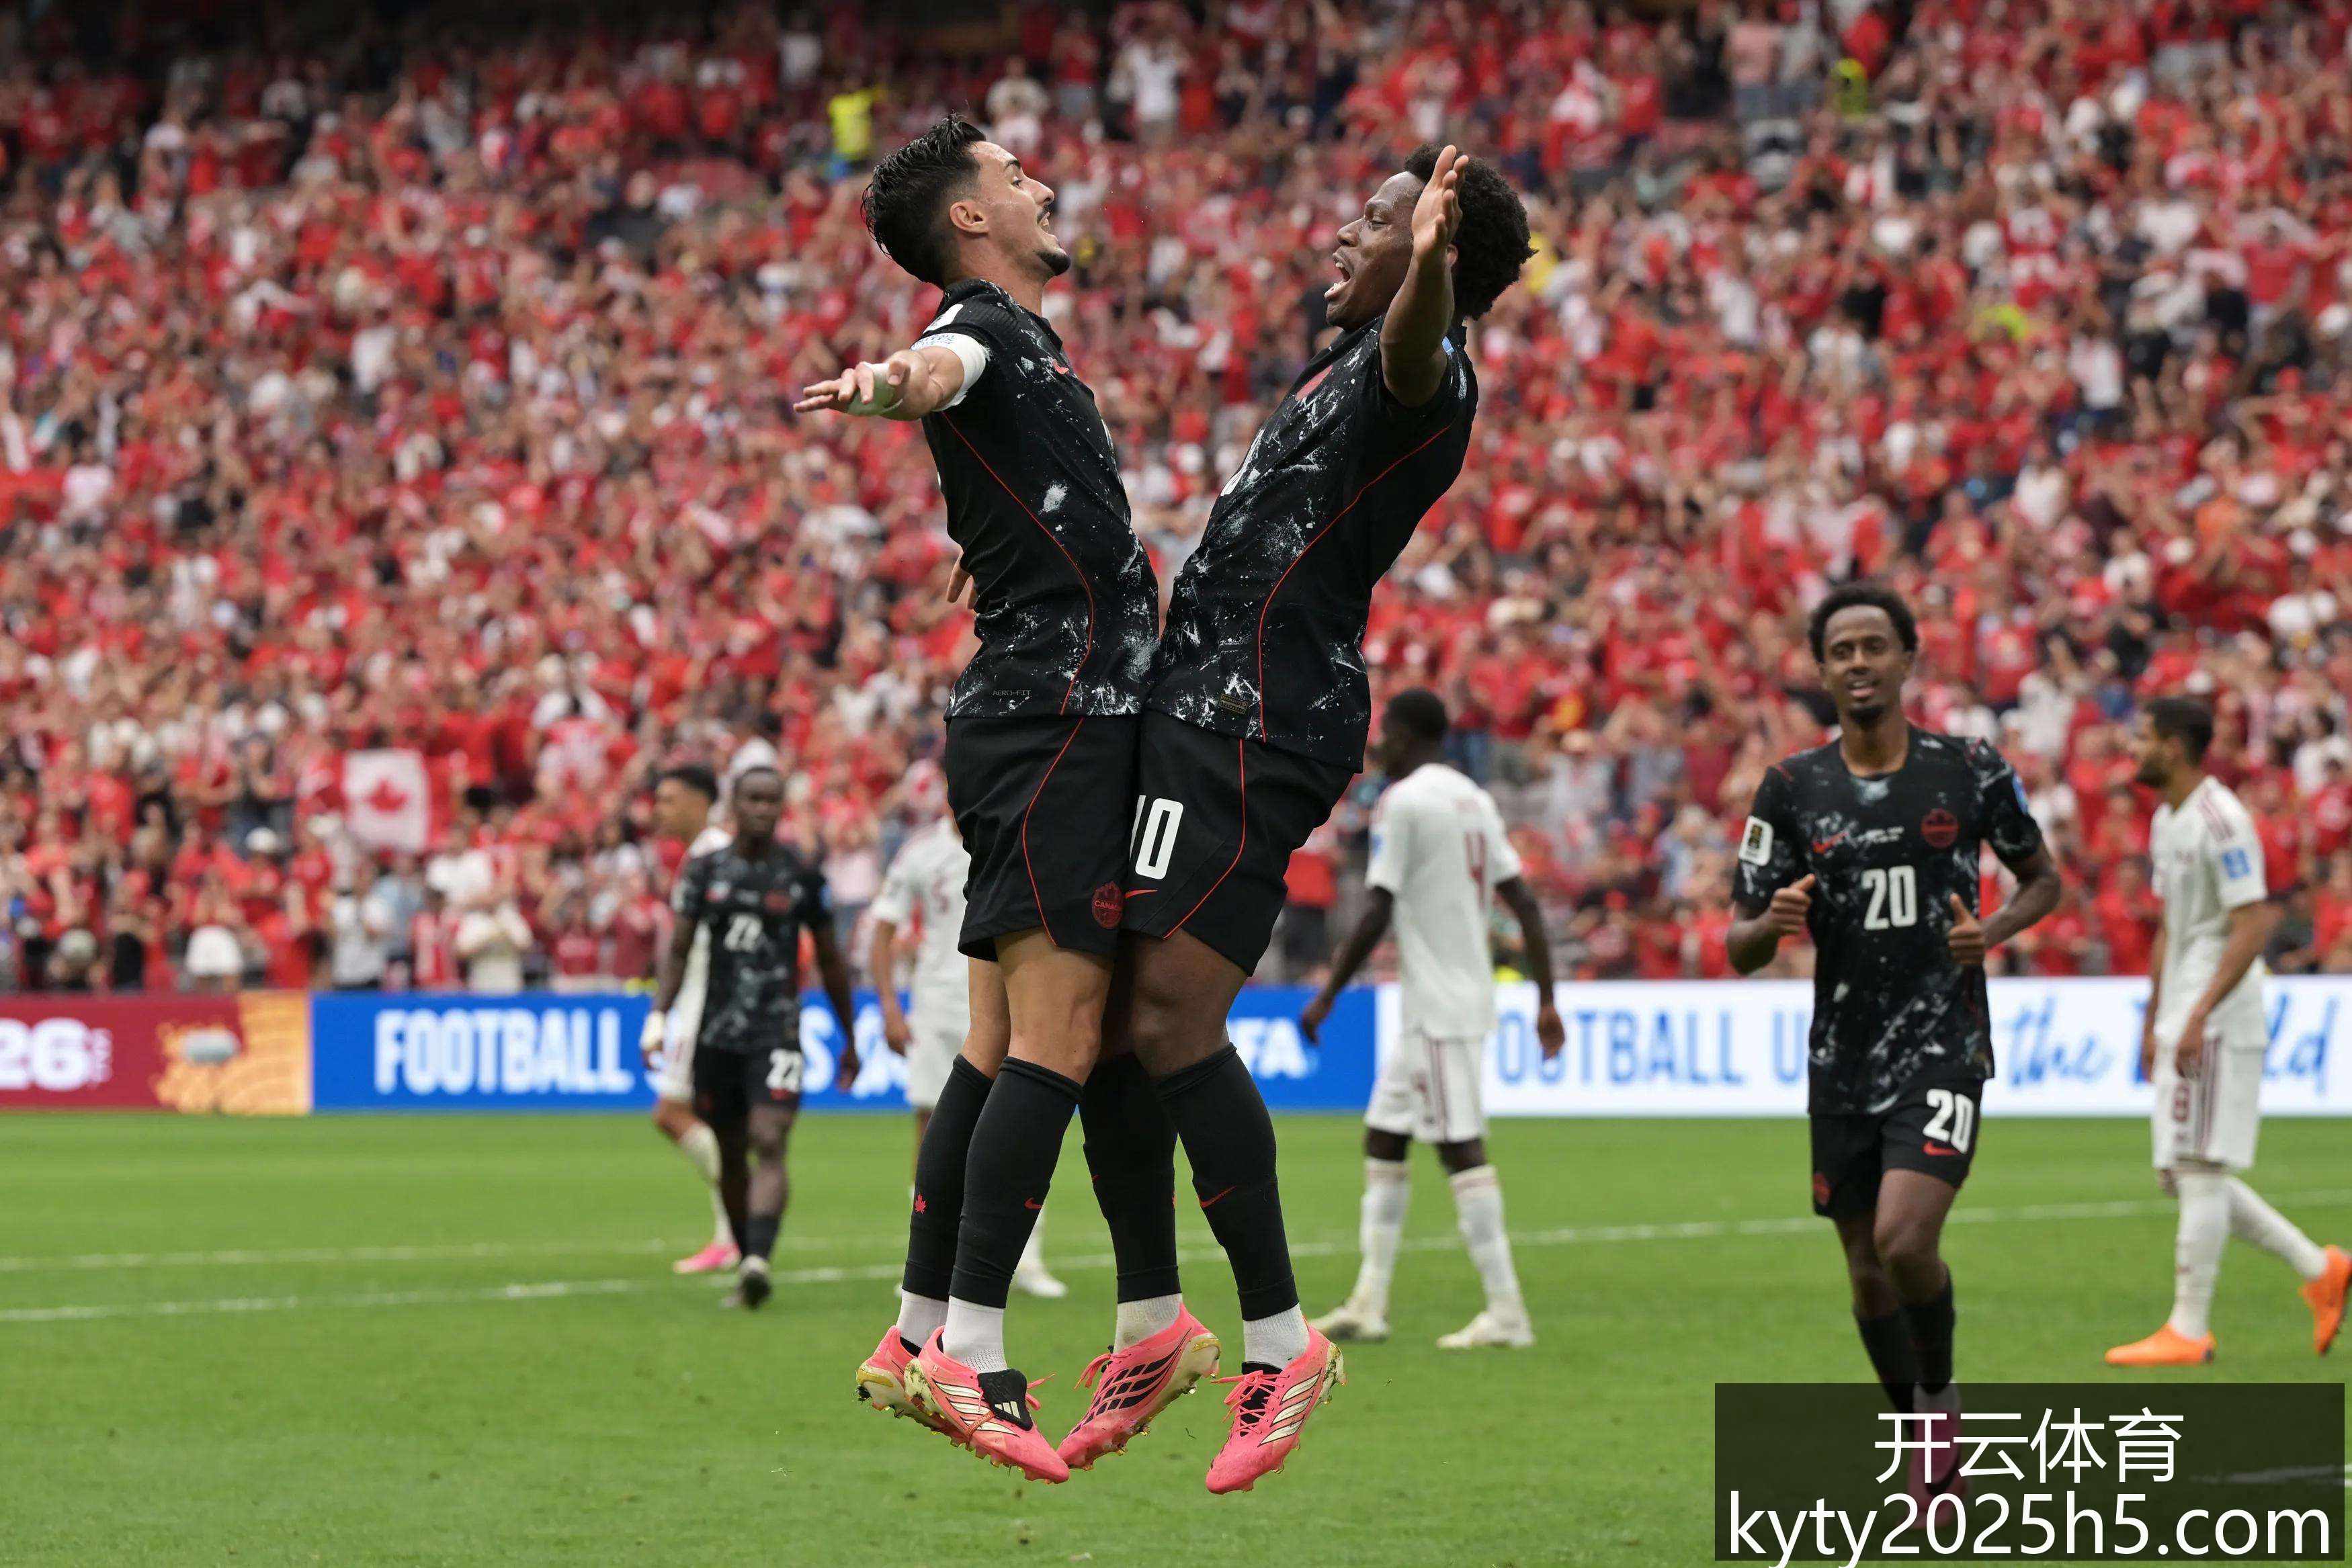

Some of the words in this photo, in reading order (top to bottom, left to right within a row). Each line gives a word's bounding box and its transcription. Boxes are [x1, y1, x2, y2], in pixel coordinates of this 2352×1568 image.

[1465, 832, 1488, 909] 4
[1861, 865, 1918, 931] 20
[374, 1009, 635, 1095] FOOTBALL
[1227, 1016, 1309, 1079] FA
[1497, 1010, 1745, 1085] OTBALL
[1999, 995, 2111, 1087] the
[1923, 1088, 1974, 1154] 20
